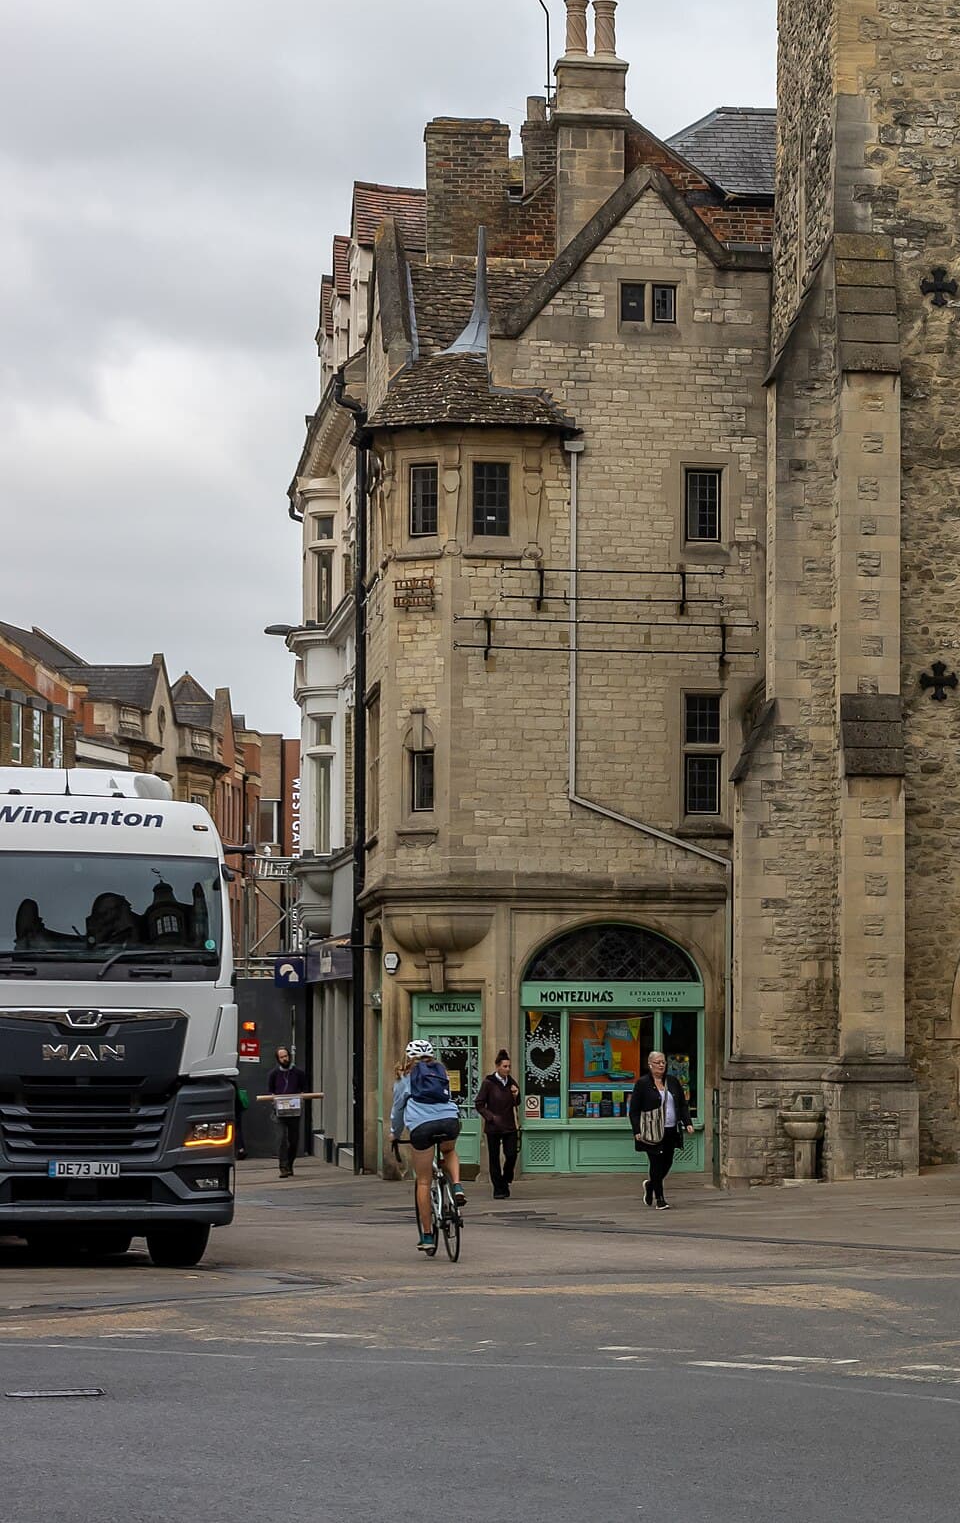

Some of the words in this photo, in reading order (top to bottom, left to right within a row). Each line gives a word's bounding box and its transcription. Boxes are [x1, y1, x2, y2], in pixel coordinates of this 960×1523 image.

[0, 806, 163, 827] Wincanton
[42, 1044, 125, 1061] MAN
[57, 1163, 90, 1175] DE73
[94, 1163, 119, 1176] JYU
